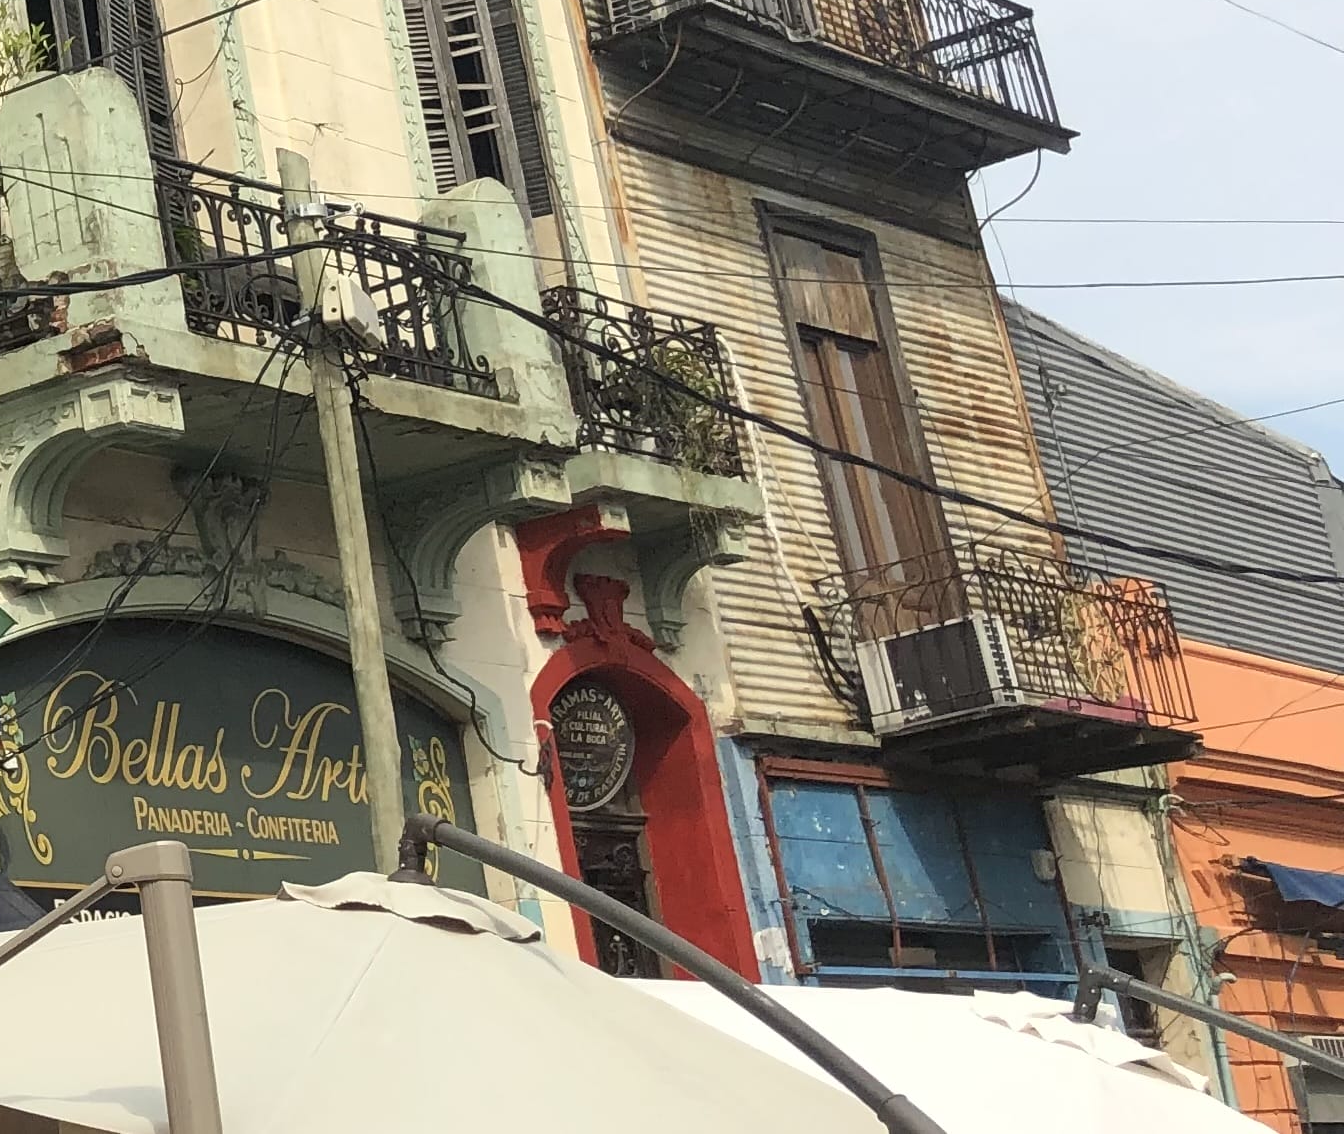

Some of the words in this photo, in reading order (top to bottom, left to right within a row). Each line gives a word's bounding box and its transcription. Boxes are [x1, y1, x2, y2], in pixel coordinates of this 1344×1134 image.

[44, 671, 226, 793] Bellas
[241, 689, 369, 804] Art
[569, 722, 609, 734] CULTURAL
[571, 733, 583, 743] LA
[585, 735, 607, 745] BOCA
[133, 796, 232, 837] PANADERIA
[246, 807, 341, 846] CONFITERIA
